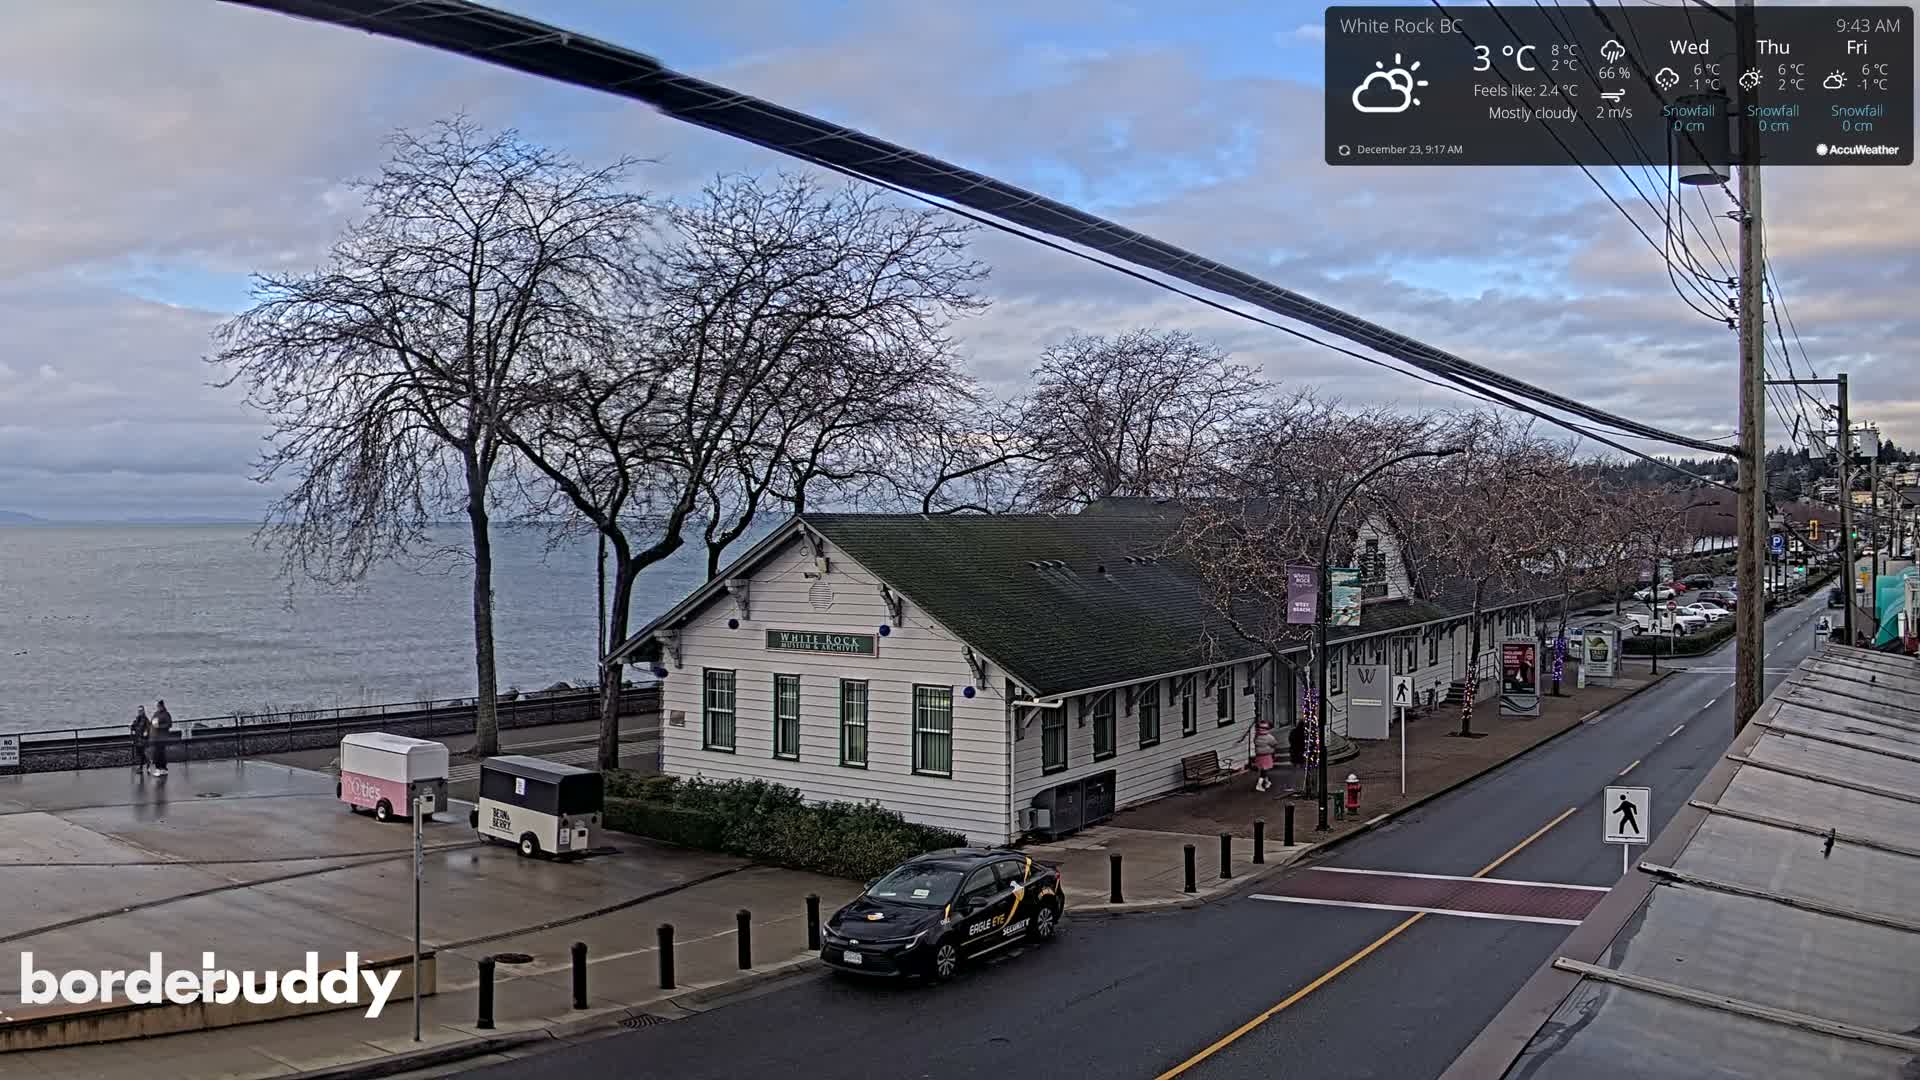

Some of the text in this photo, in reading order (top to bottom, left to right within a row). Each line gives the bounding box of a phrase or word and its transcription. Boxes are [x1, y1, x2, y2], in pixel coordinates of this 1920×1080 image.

[780, 632, 859, 647] WHITE ROCK
[781, 641, 811, 649] MUSEUM
[822, 643, 859, 652] ARCHIVES
[969, 913, 1006, 936] EAGLE EYE
[1003, 918, 1030, 936] SECURITY
